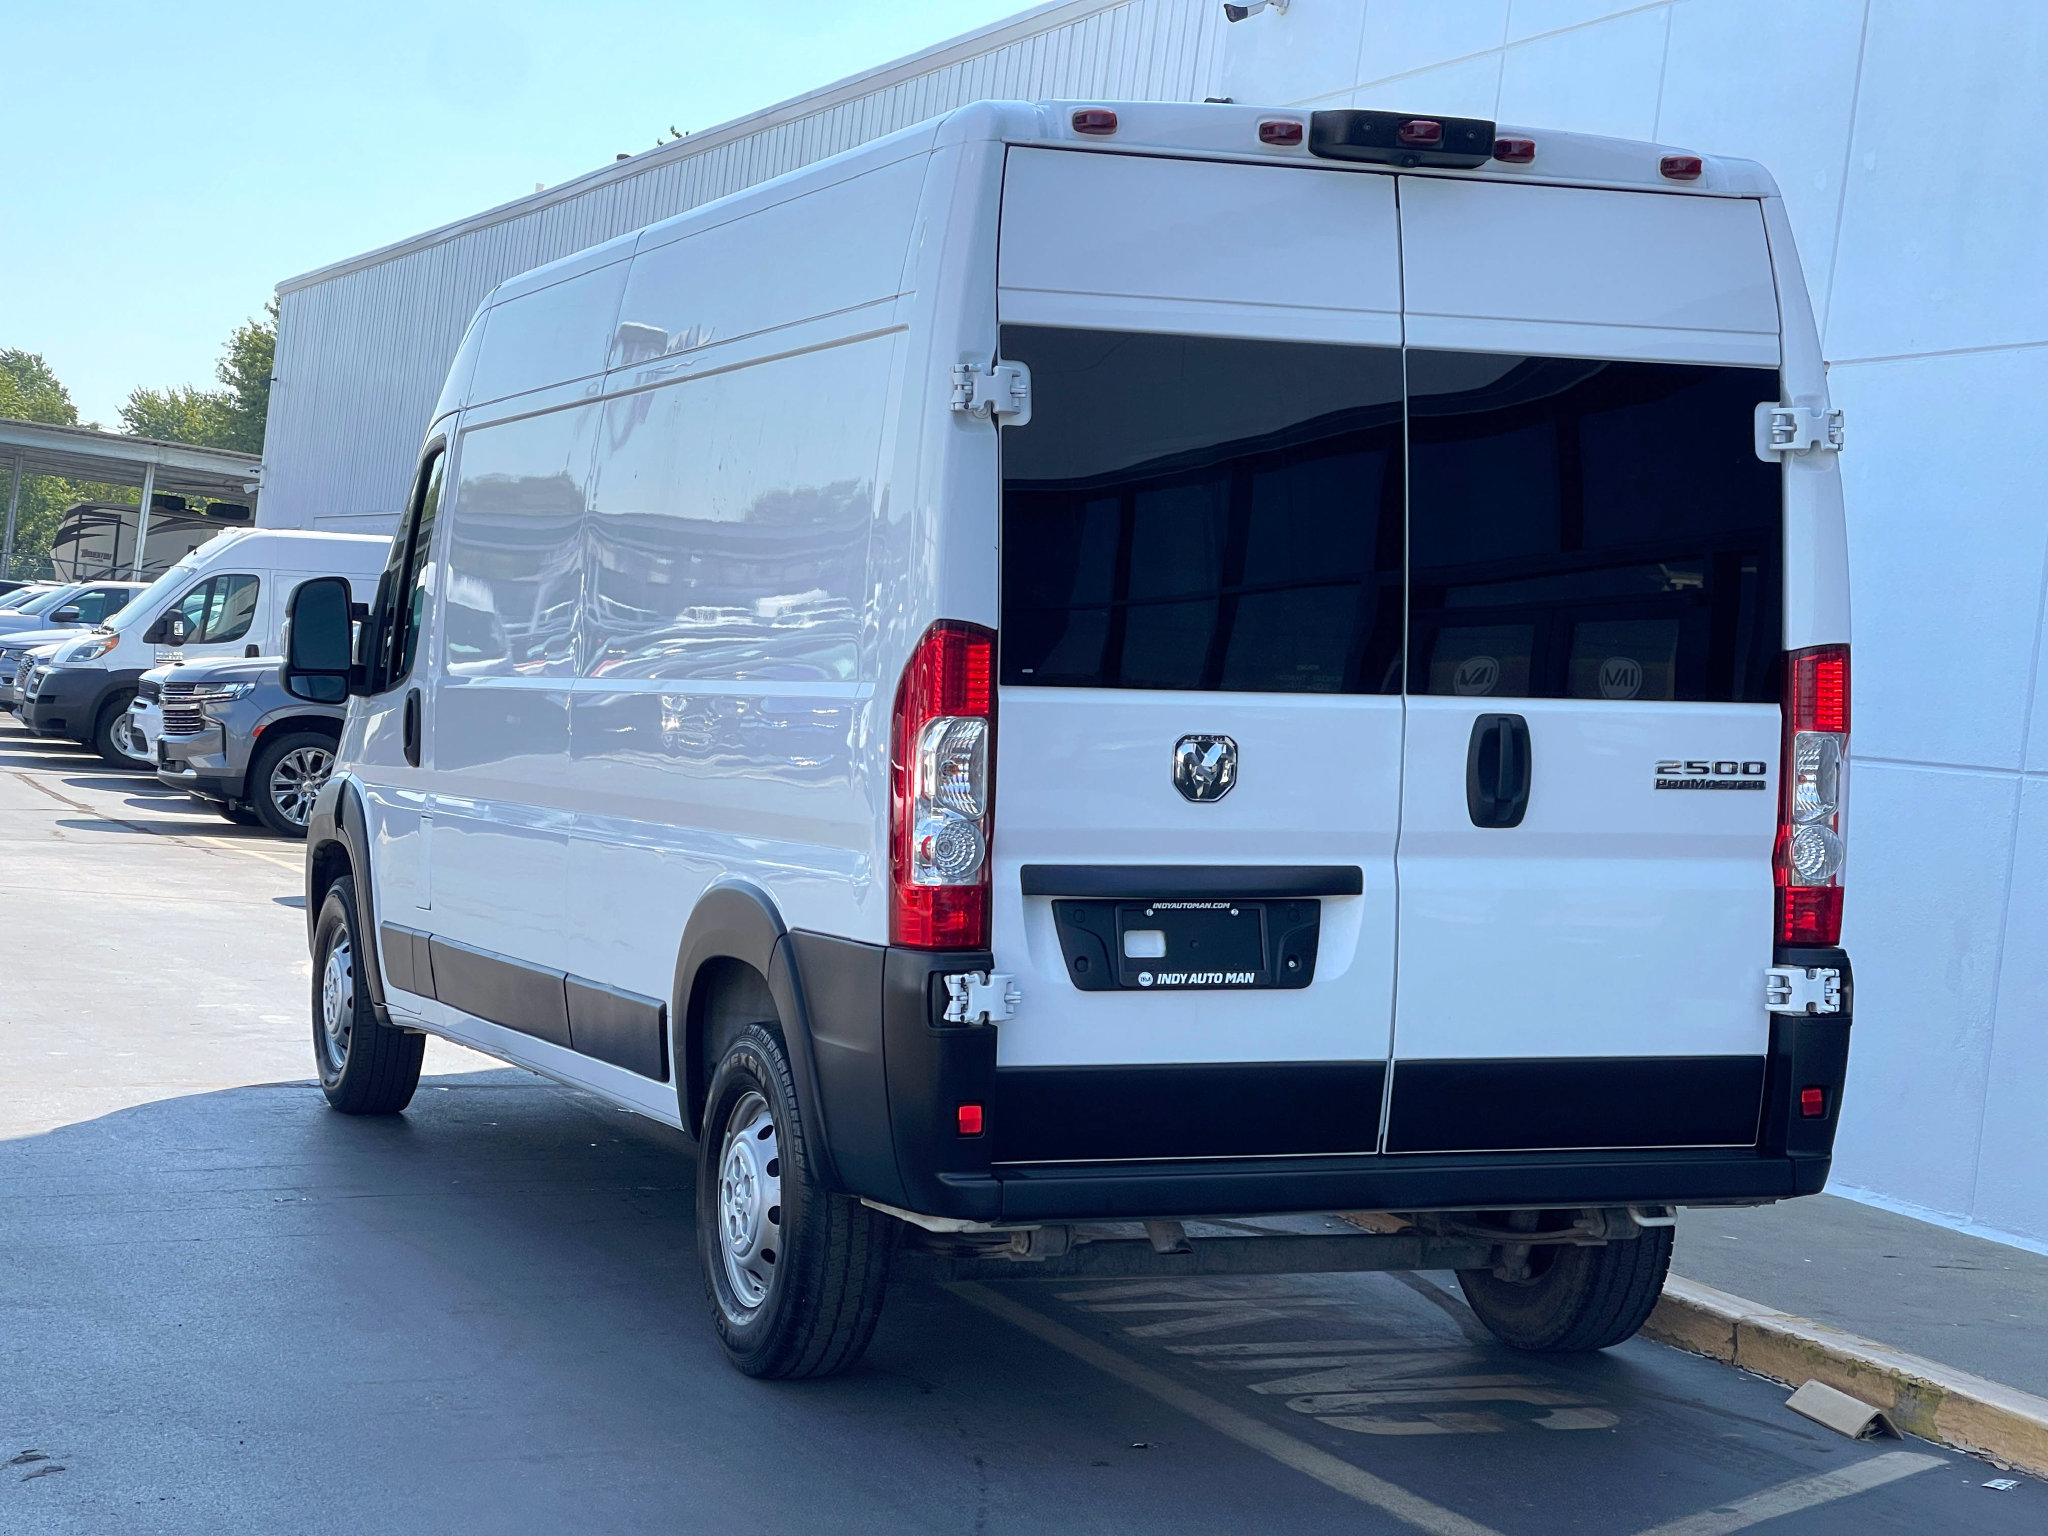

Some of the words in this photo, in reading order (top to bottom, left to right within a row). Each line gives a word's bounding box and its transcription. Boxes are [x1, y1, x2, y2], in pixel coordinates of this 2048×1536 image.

[1655, 760, 1767, 775] 2500
[1156, 973, 1188, 985] INDY
[1188, 972, 1223, 985] AUTO
[1225, 972, 1255, 984] MAN
[720, 1053, 767, 1089] NEXEN
